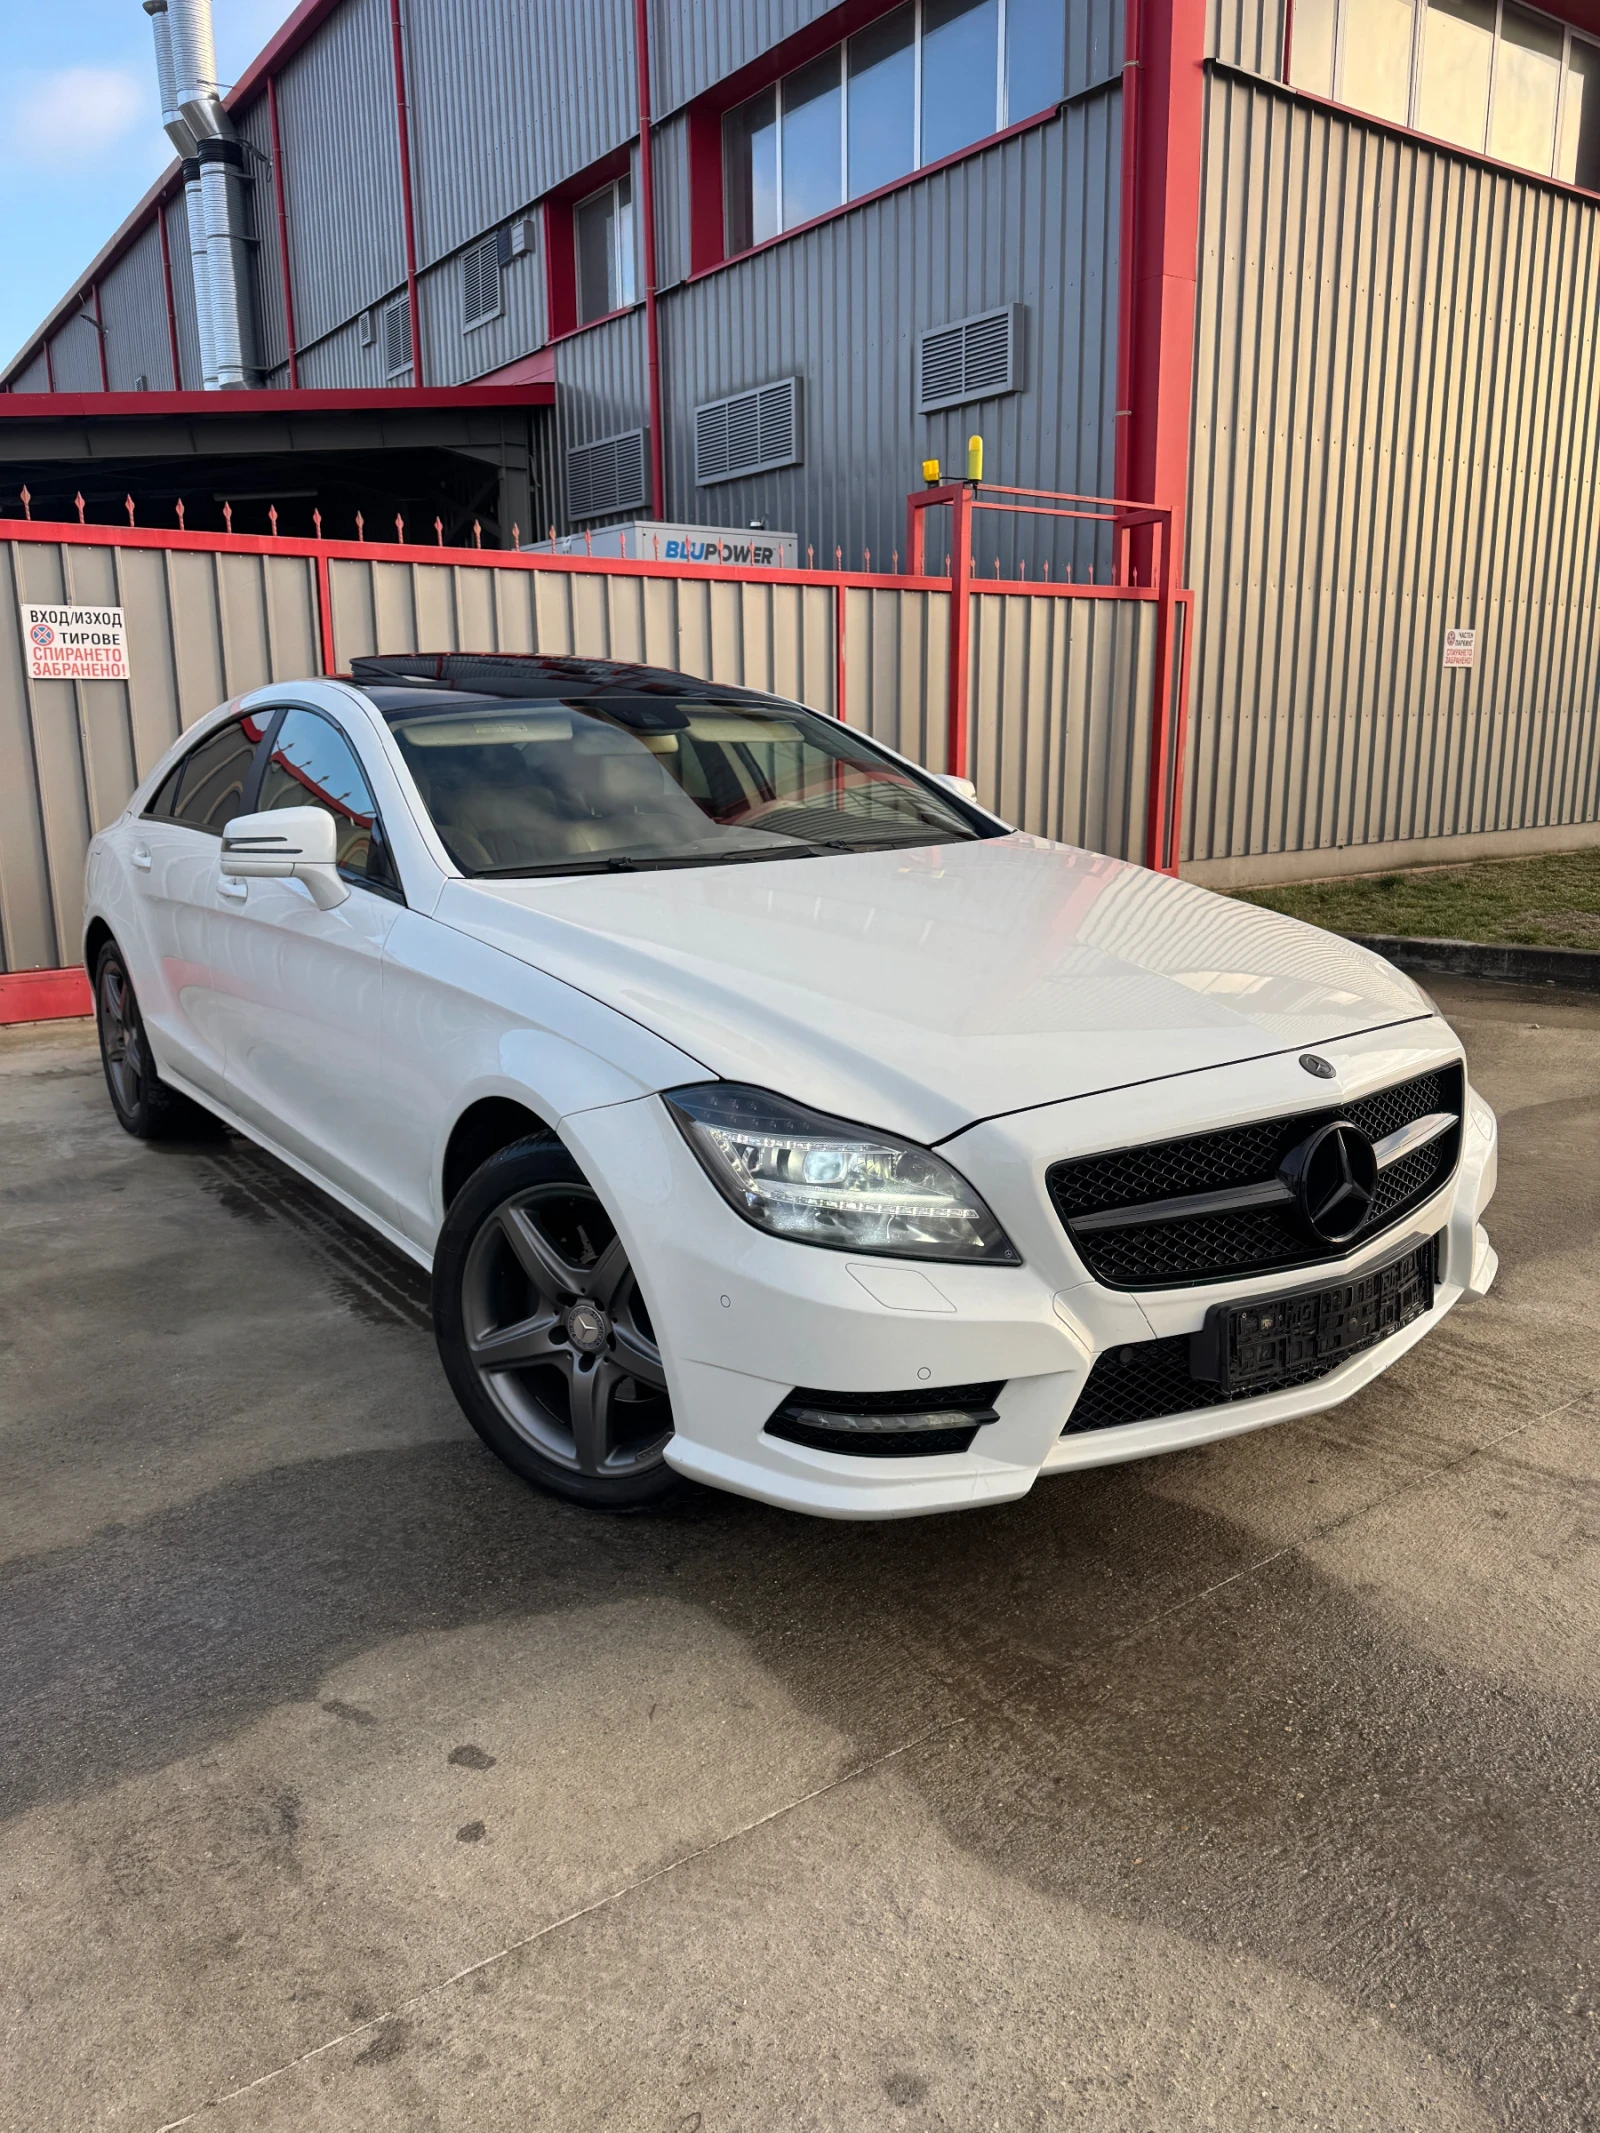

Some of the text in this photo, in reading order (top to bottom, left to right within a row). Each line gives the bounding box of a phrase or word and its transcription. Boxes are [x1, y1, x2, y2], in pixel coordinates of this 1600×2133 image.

[665, 540, 774, 565] BLUPOWER
[30, 610, 122, 628] ВХОД/ИЗХОД
[59, 632, 121, 646] ТИРОВЕ
[32, 647, 122, 662] СПИРАНЕТО
[32, 662, 126, 677] ЗАБРАНЕНО!
